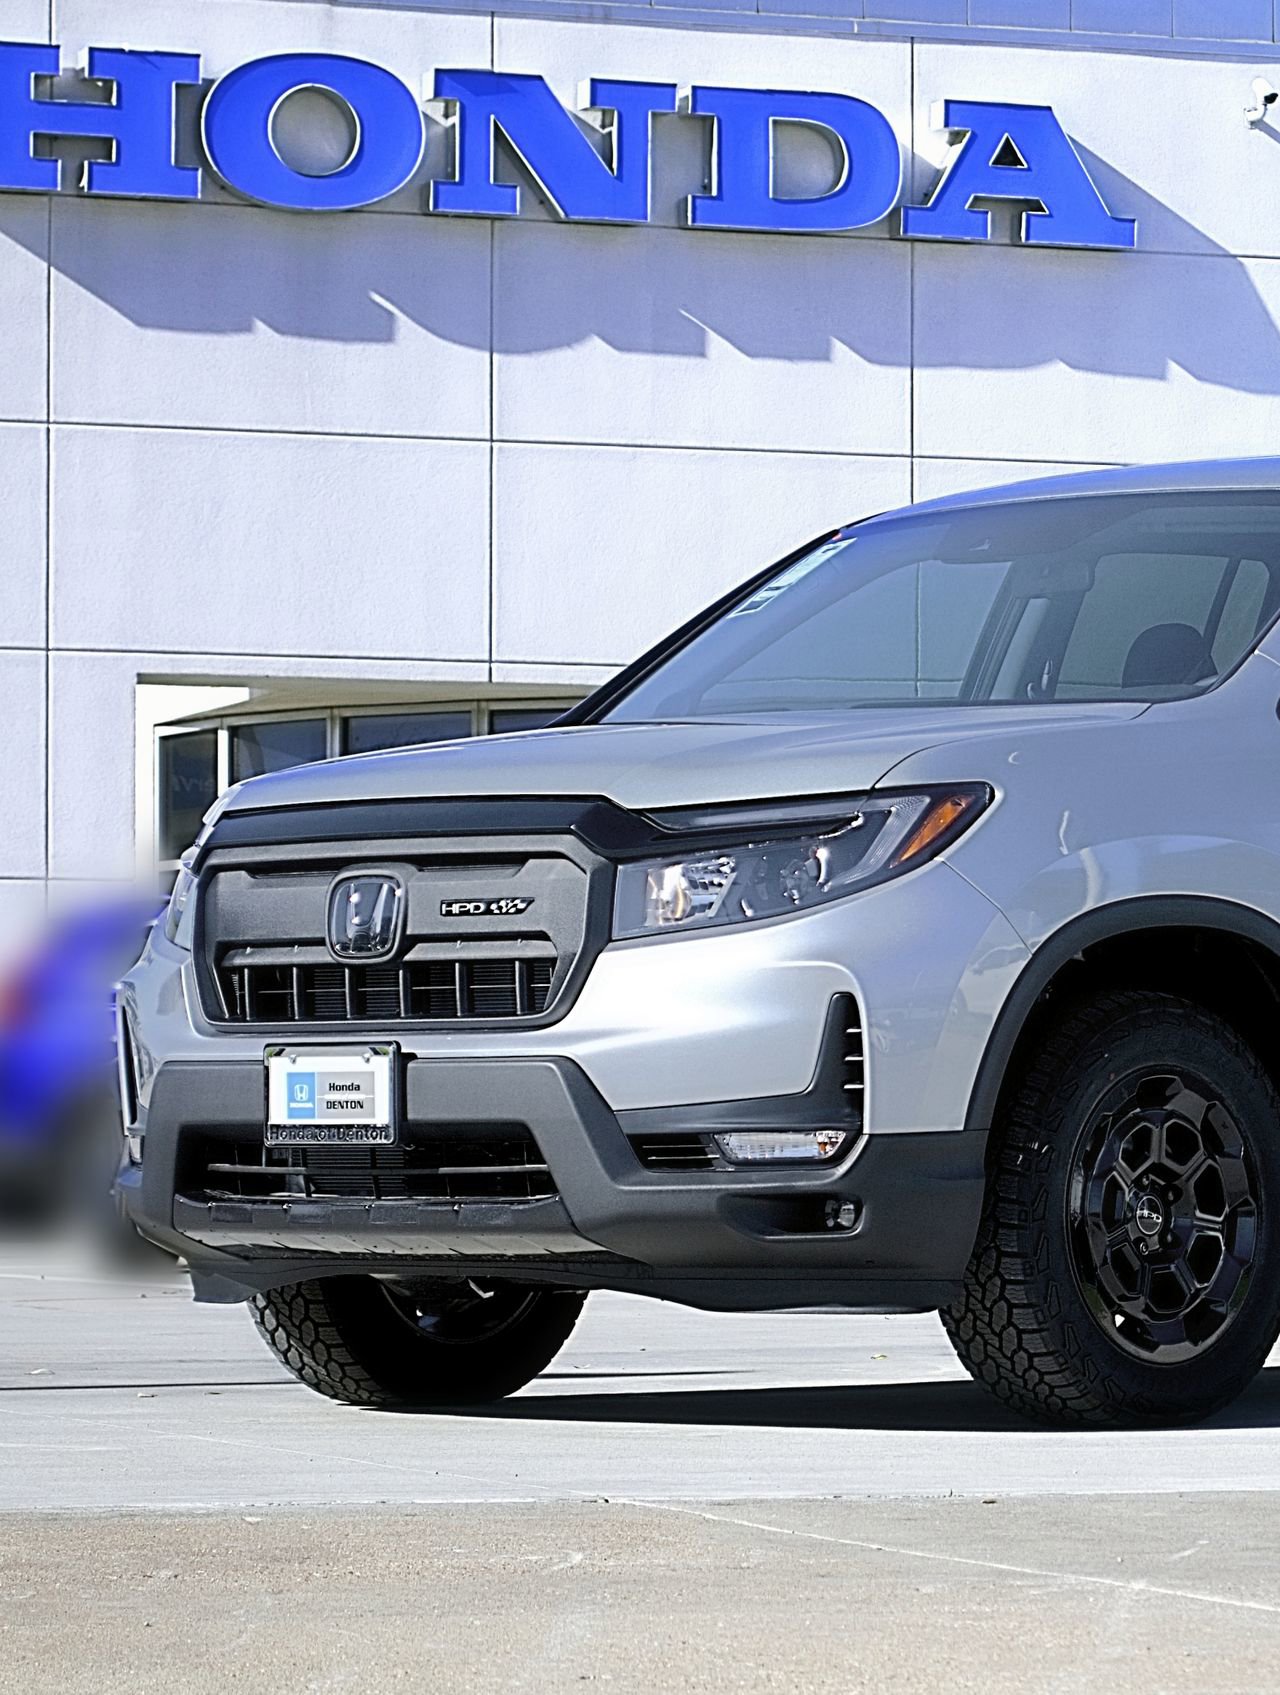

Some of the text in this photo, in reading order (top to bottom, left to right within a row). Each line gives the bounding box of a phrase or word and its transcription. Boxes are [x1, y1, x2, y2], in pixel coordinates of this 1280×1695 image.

[0, 41, 1137, 250] HONDA
[442, 902, 485, 914] HPD
[328, 1082, 361, 1091] Honda
[326, 1100, 364, 1110] DENTON
[270, 1126, 315, 1141] Honda
[336, 1126, 388, 1141] Denton
